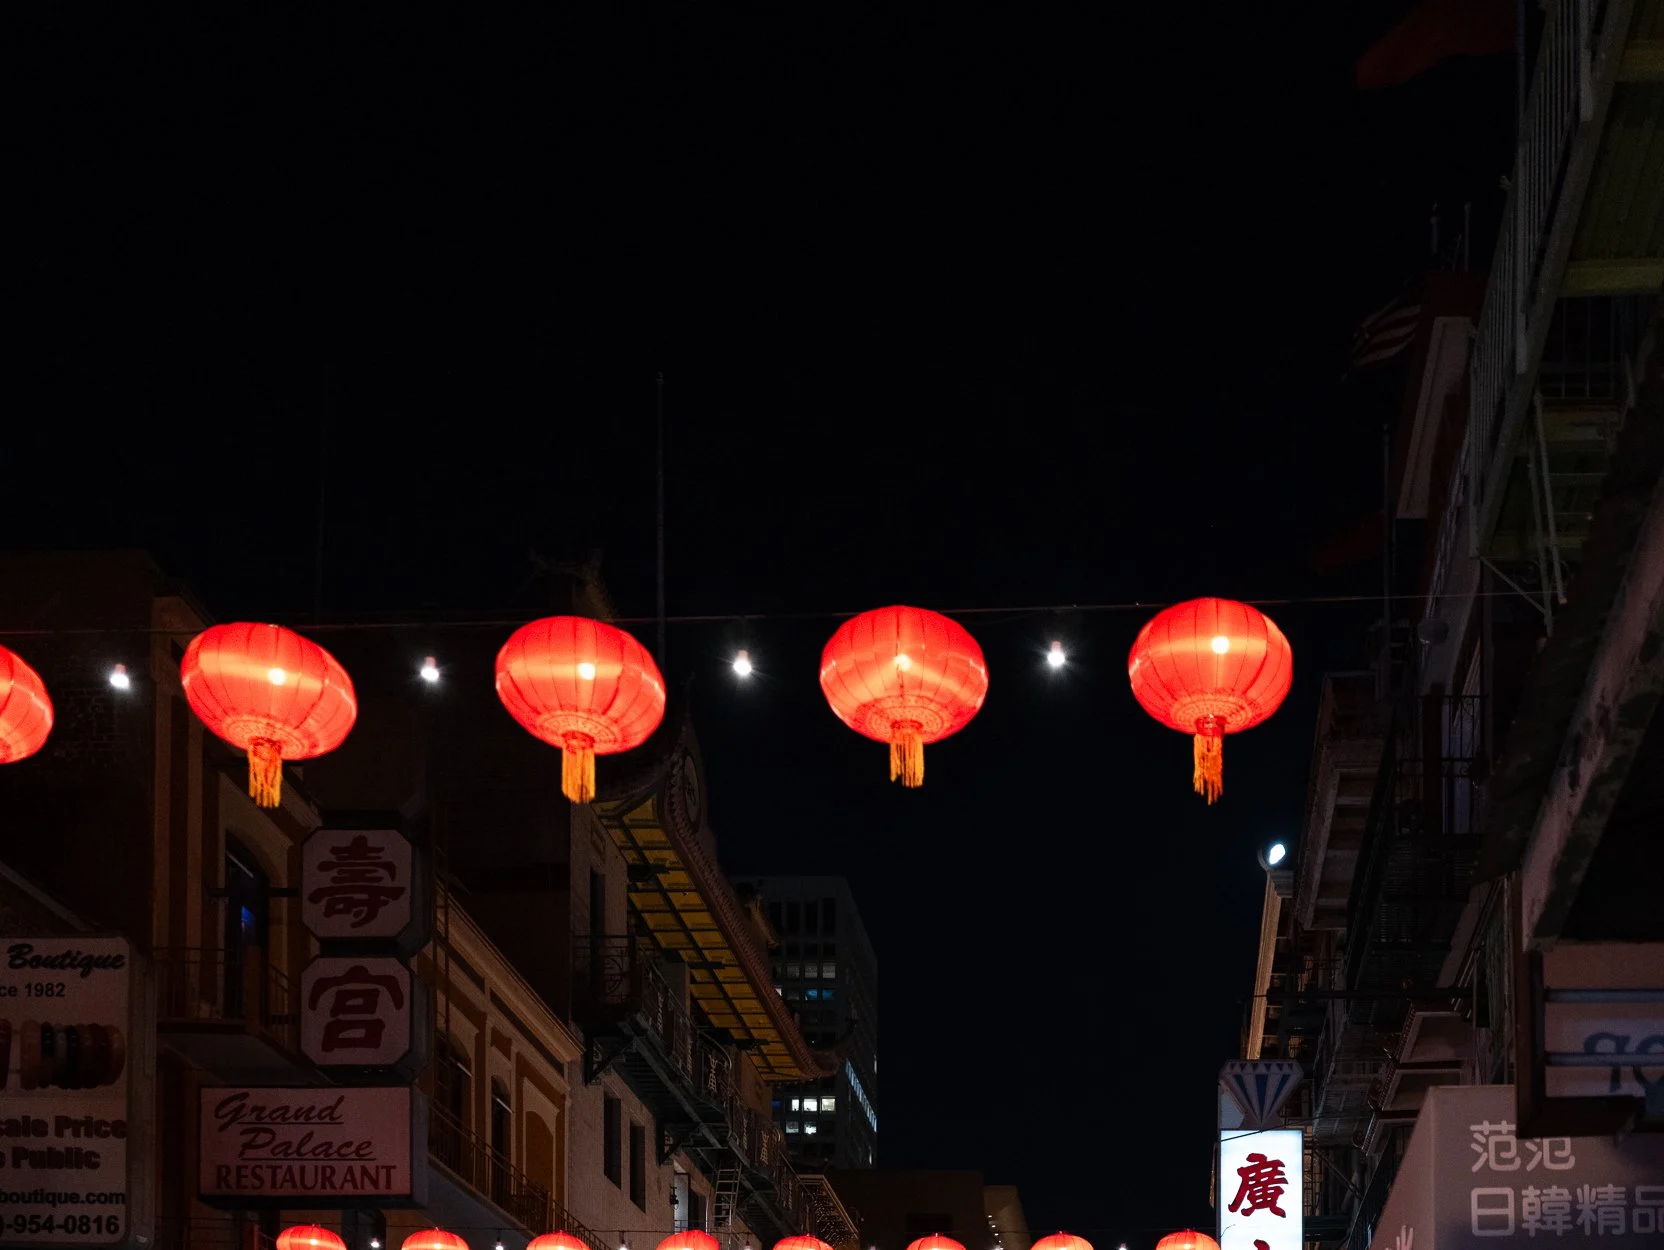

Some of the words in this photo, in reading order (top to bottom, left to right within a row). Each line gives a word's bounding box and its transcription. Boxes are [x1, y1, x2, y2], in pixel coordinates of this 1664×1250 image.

[308, 835, 405, 1052] 壽宮
[8, 943, 125, 978] Boutique
[24, 983, 66, 998] 1982
[54, 1115, 127, 1138] Price
[214, 1091, 344, 1132] Grand
[12, 1147, 99, 1169] Public
[238, 1127, 373, 1159] Palace
[216, 1165, 396, 1191] RESTAURANT
[1470, 1183, 1664, 1238] 日韓精品
